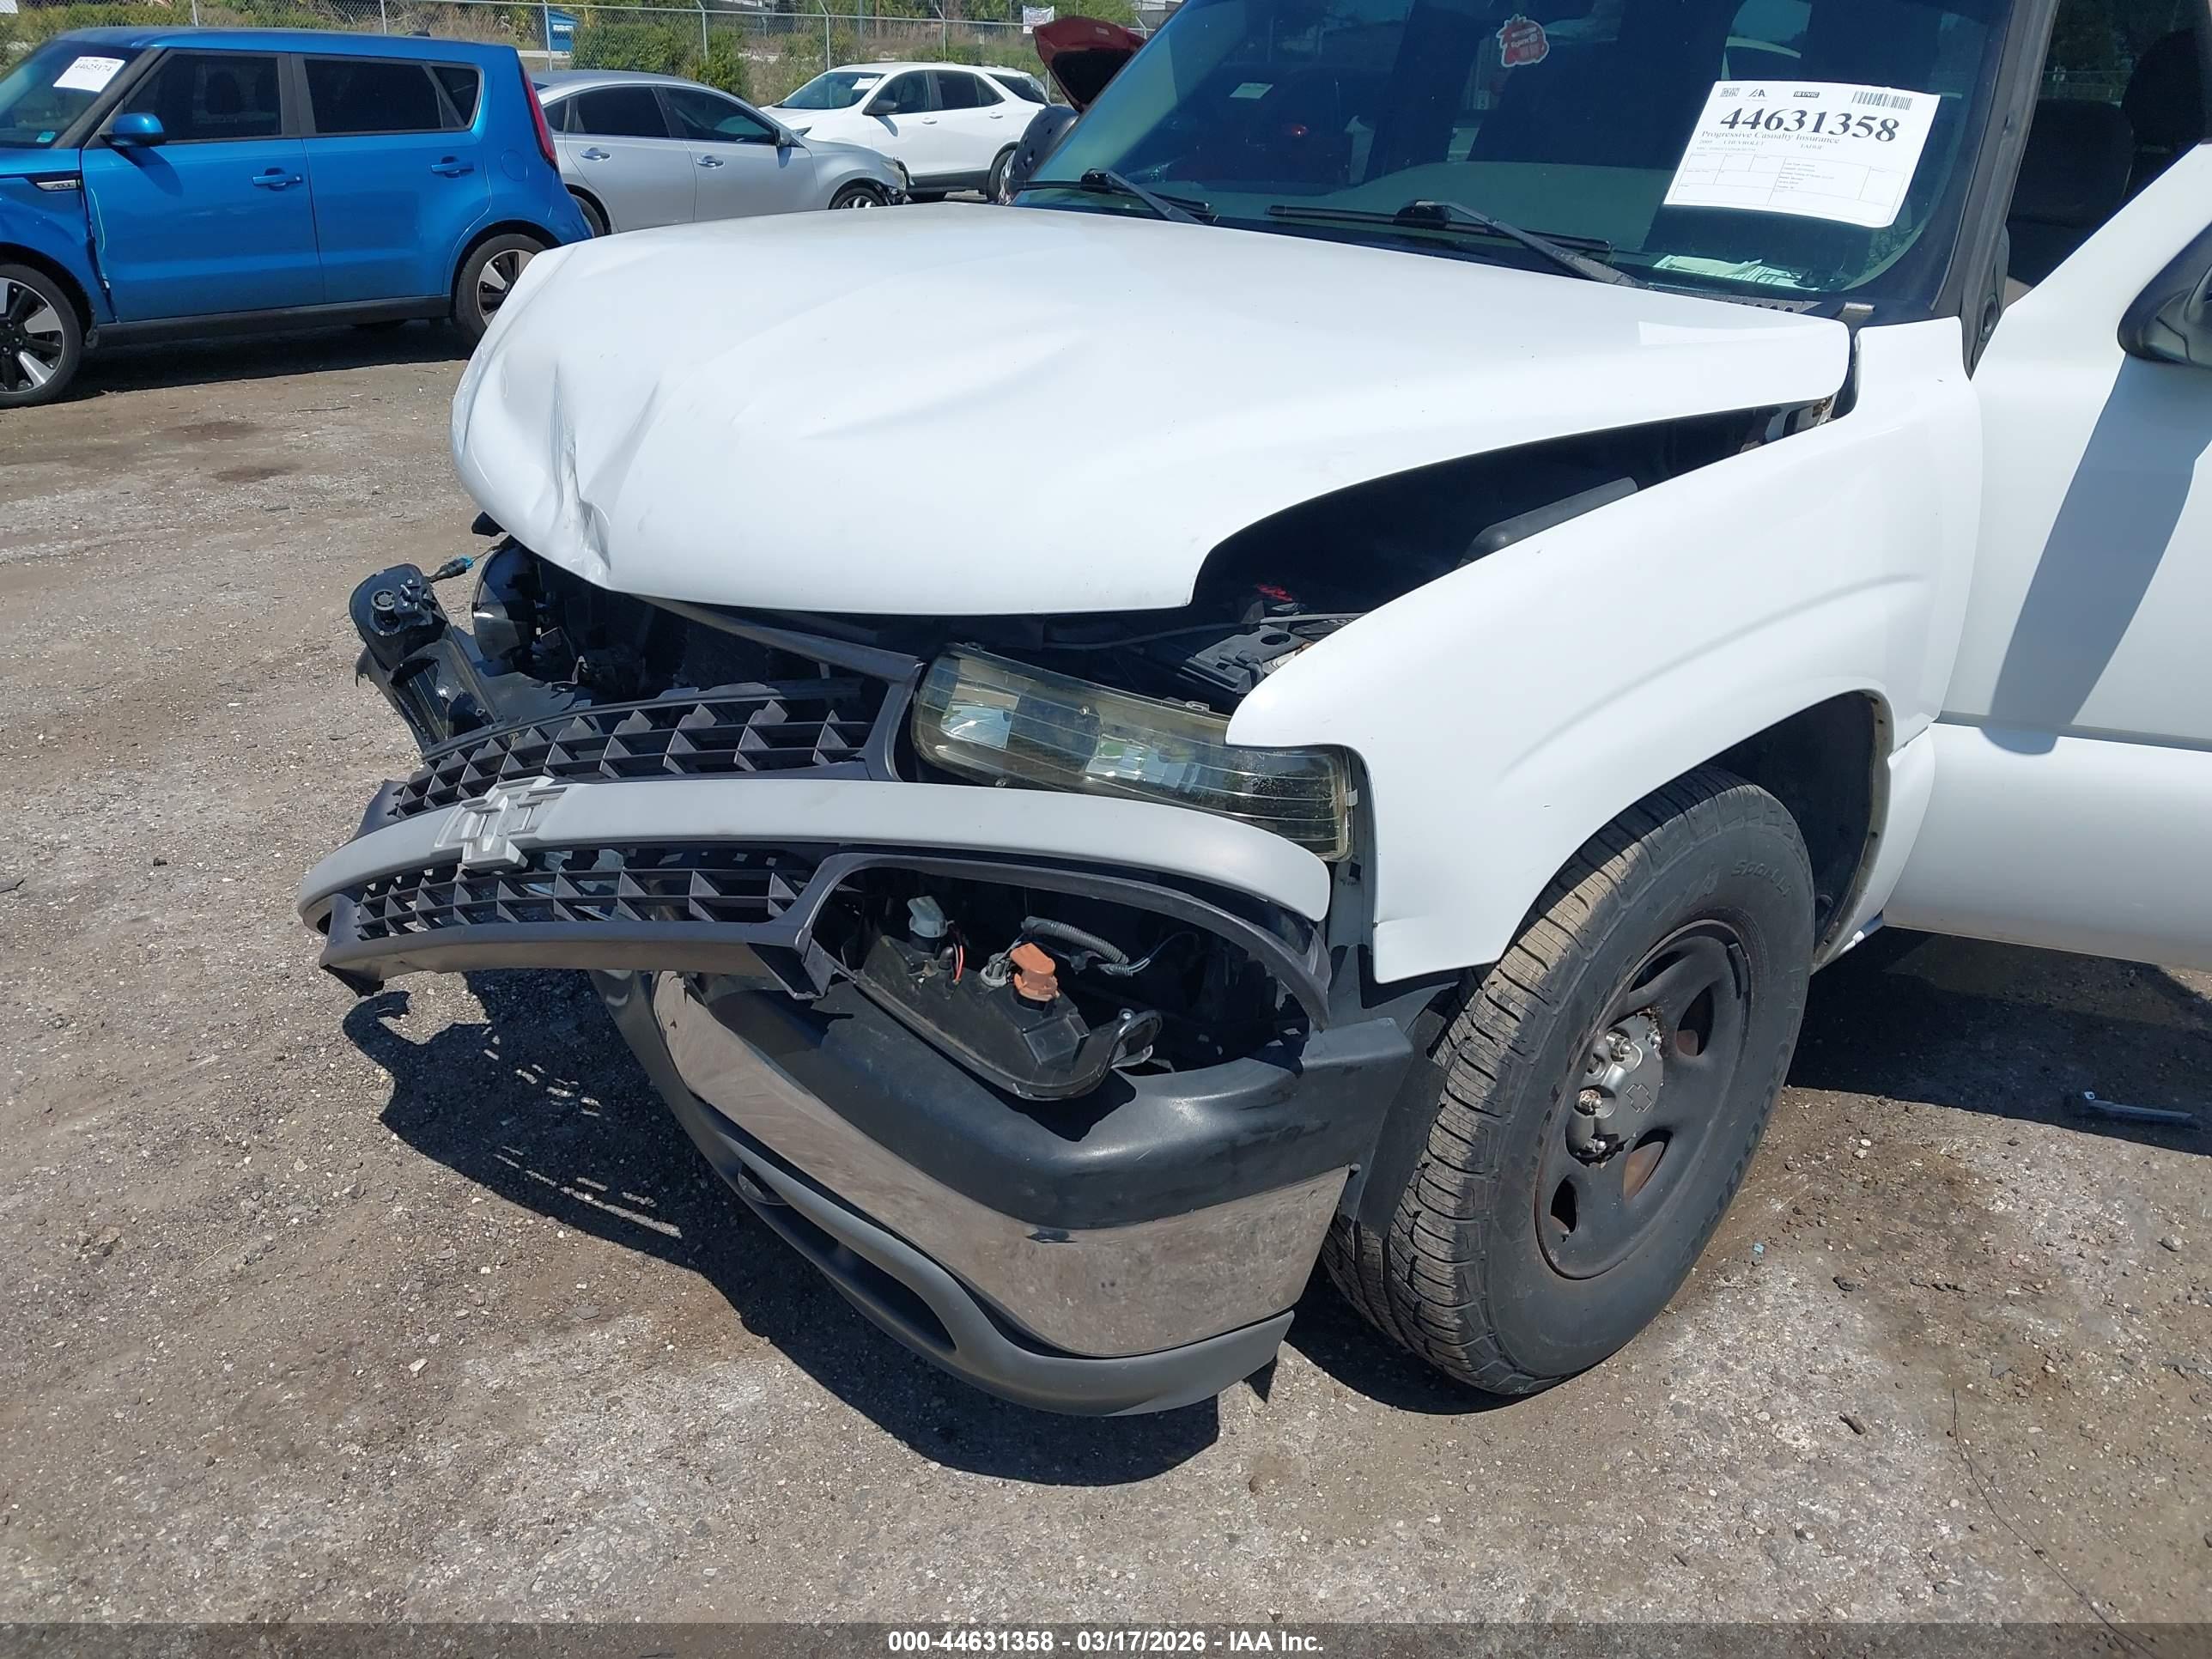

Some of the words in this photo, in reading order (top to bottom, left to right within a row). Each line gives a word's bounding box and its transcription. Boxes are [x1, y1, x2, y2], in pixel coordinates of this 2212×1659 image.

[1720, 107, 1900, 142] 44631358
[1702, 131, 1753, 139] Progressive
[1754, 132, 1794, 142] Casualty
[1796, 134, 1840, 144] Insurance
